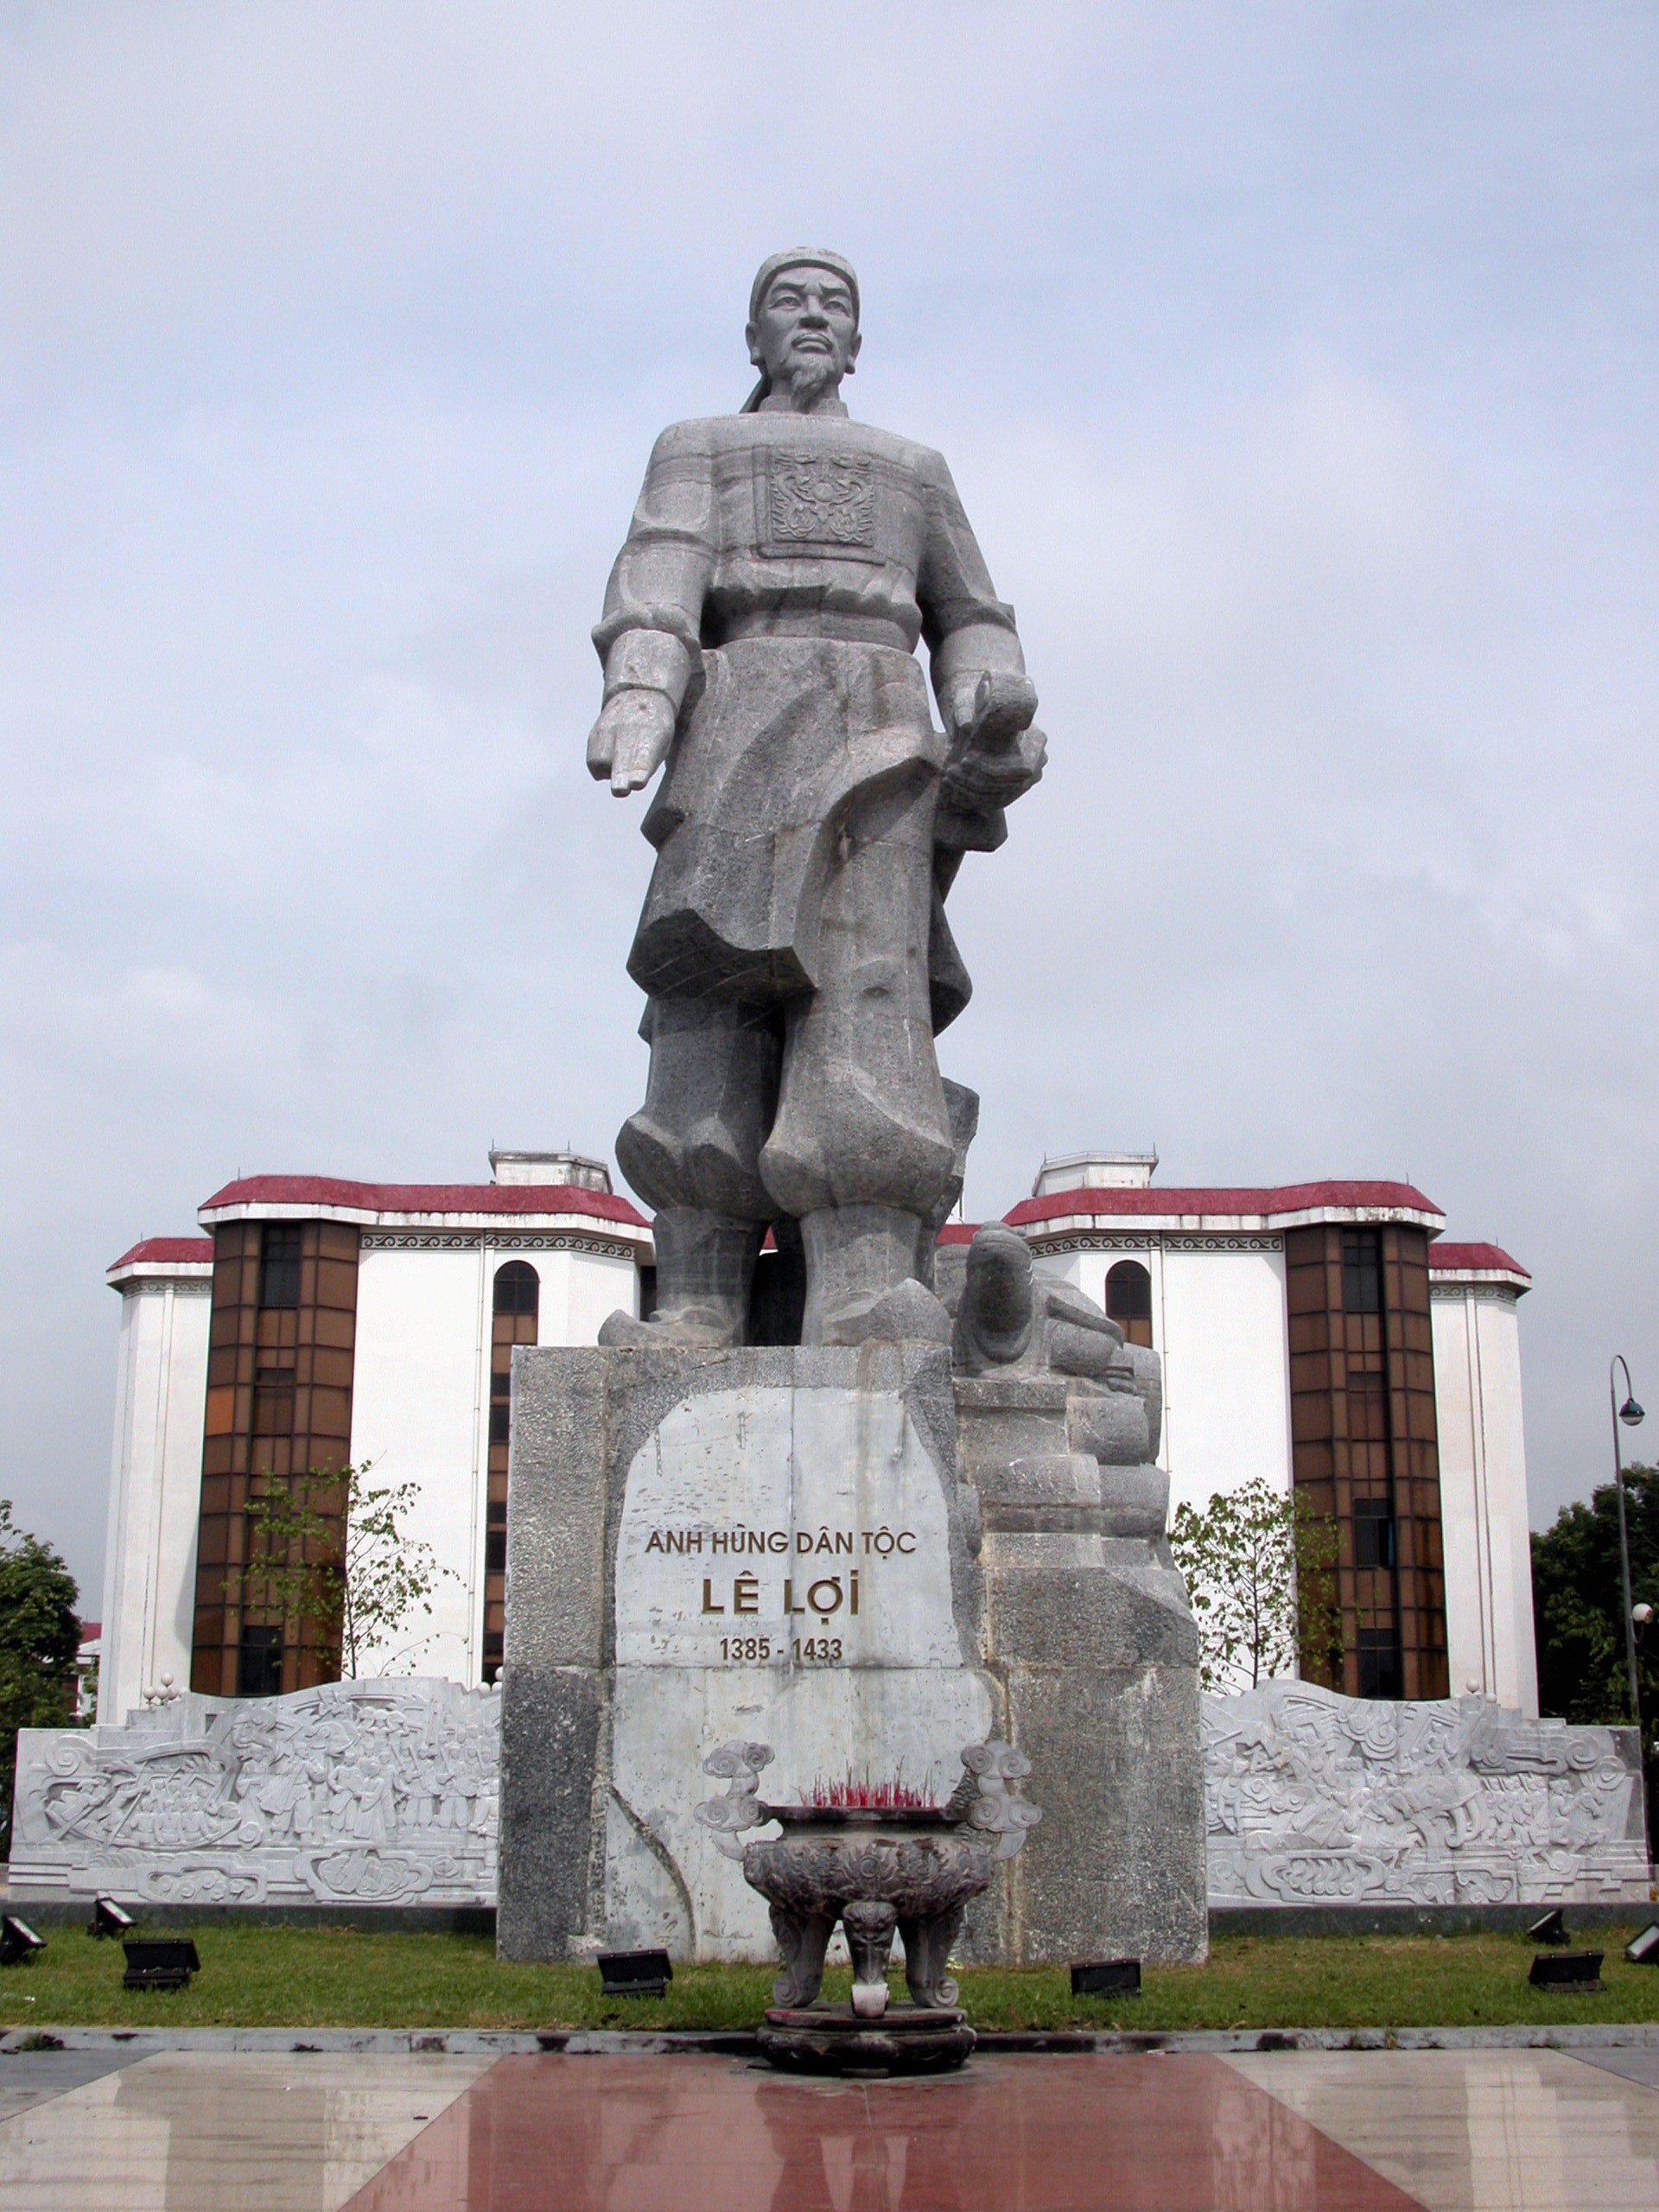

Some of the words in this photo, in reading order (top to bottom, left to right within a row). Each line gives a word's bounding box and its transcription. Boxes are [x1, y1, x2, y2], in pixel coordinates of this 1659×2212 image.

[645, 1530, 703, 1554] ANH
[712, 1523, 789, 1554] HÙNG
[797, 1525, 853, 1554] DÂN
[861, 1525, 917, 1560] TỘC
[702, 1570, 759, 1614] LÊ
[720, 1638, 770, 1660] 1385
[792, 1638, 842, 1661] 1433
